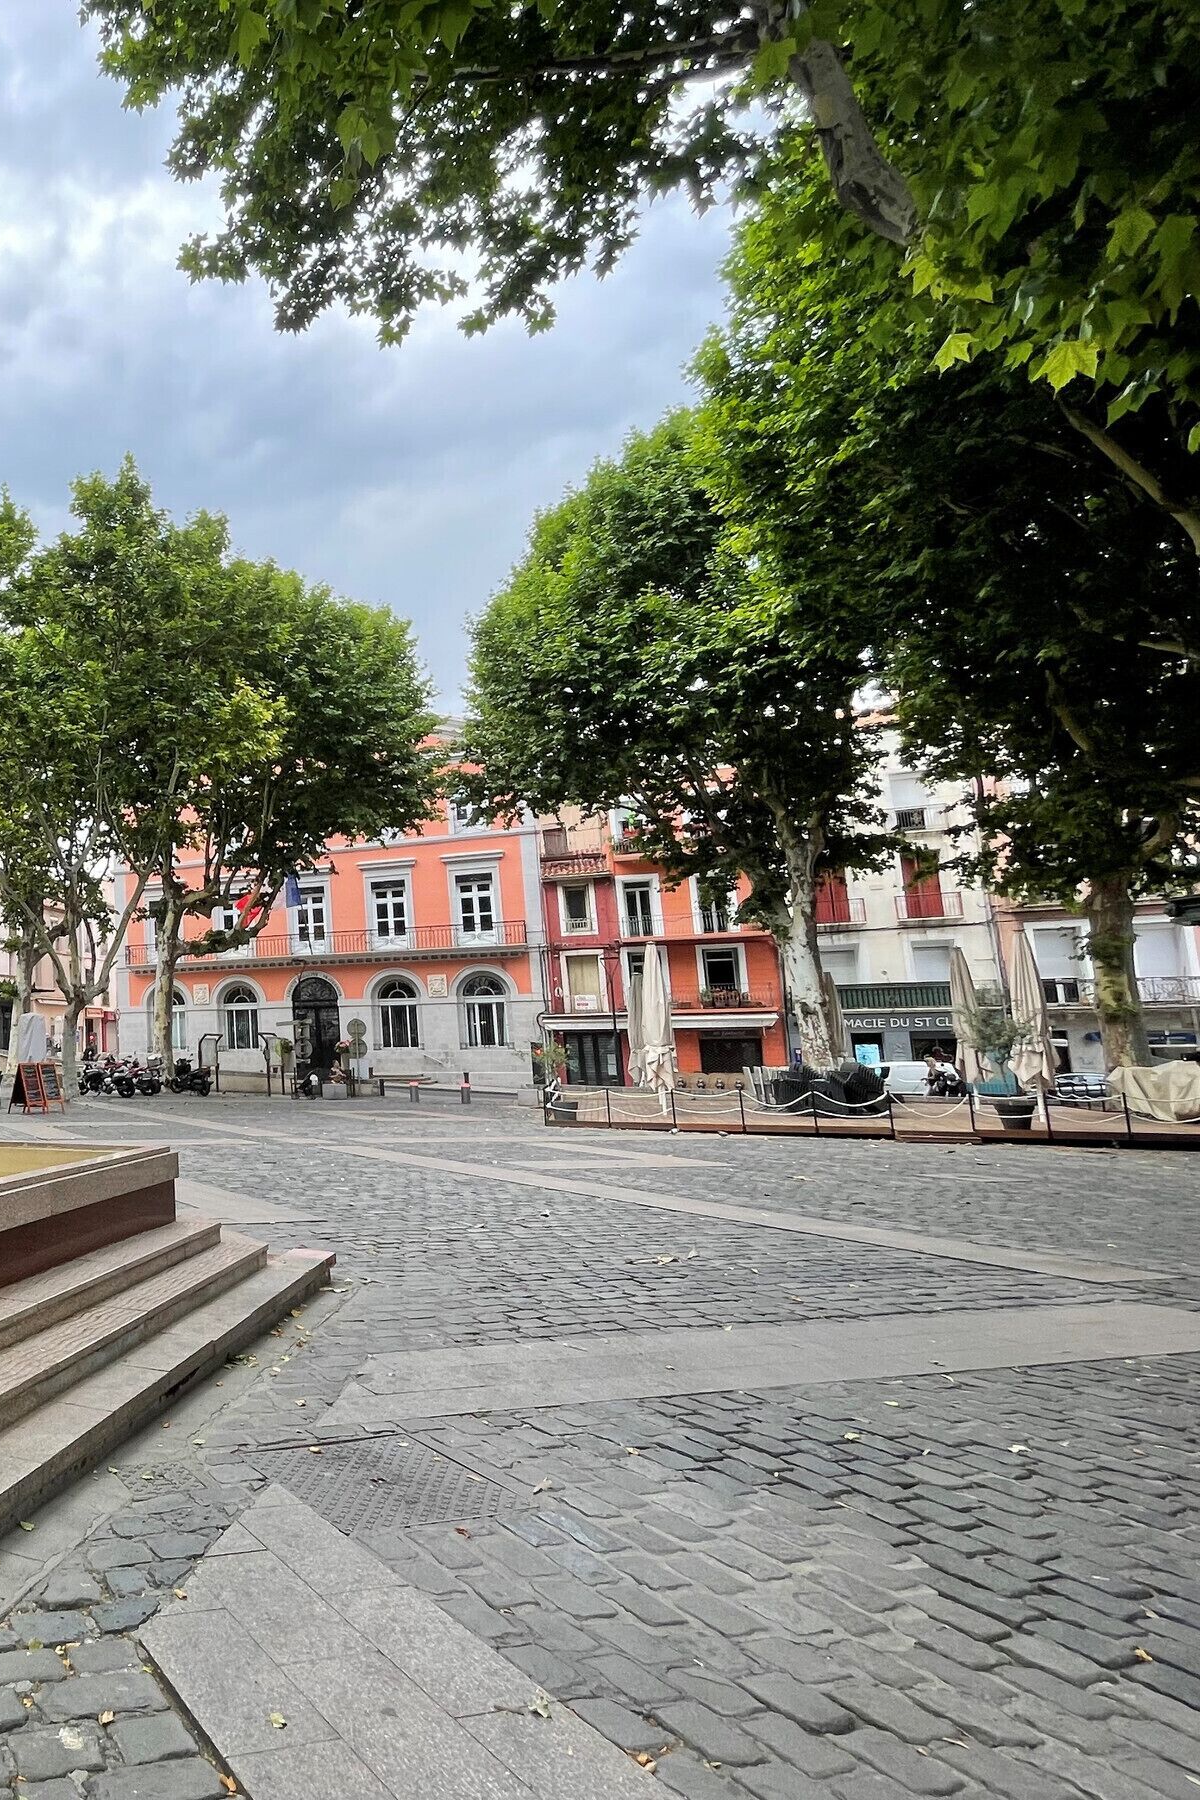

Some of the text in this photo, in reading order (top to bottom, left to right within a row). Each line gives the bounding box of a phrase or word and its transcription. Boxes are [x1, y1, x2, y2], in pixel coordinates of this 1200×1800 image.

[843, 1018, 886, 1028] MACIE
[890, 1018, 910, 1027] DU
[914, 1017, 932, 1027] ST
